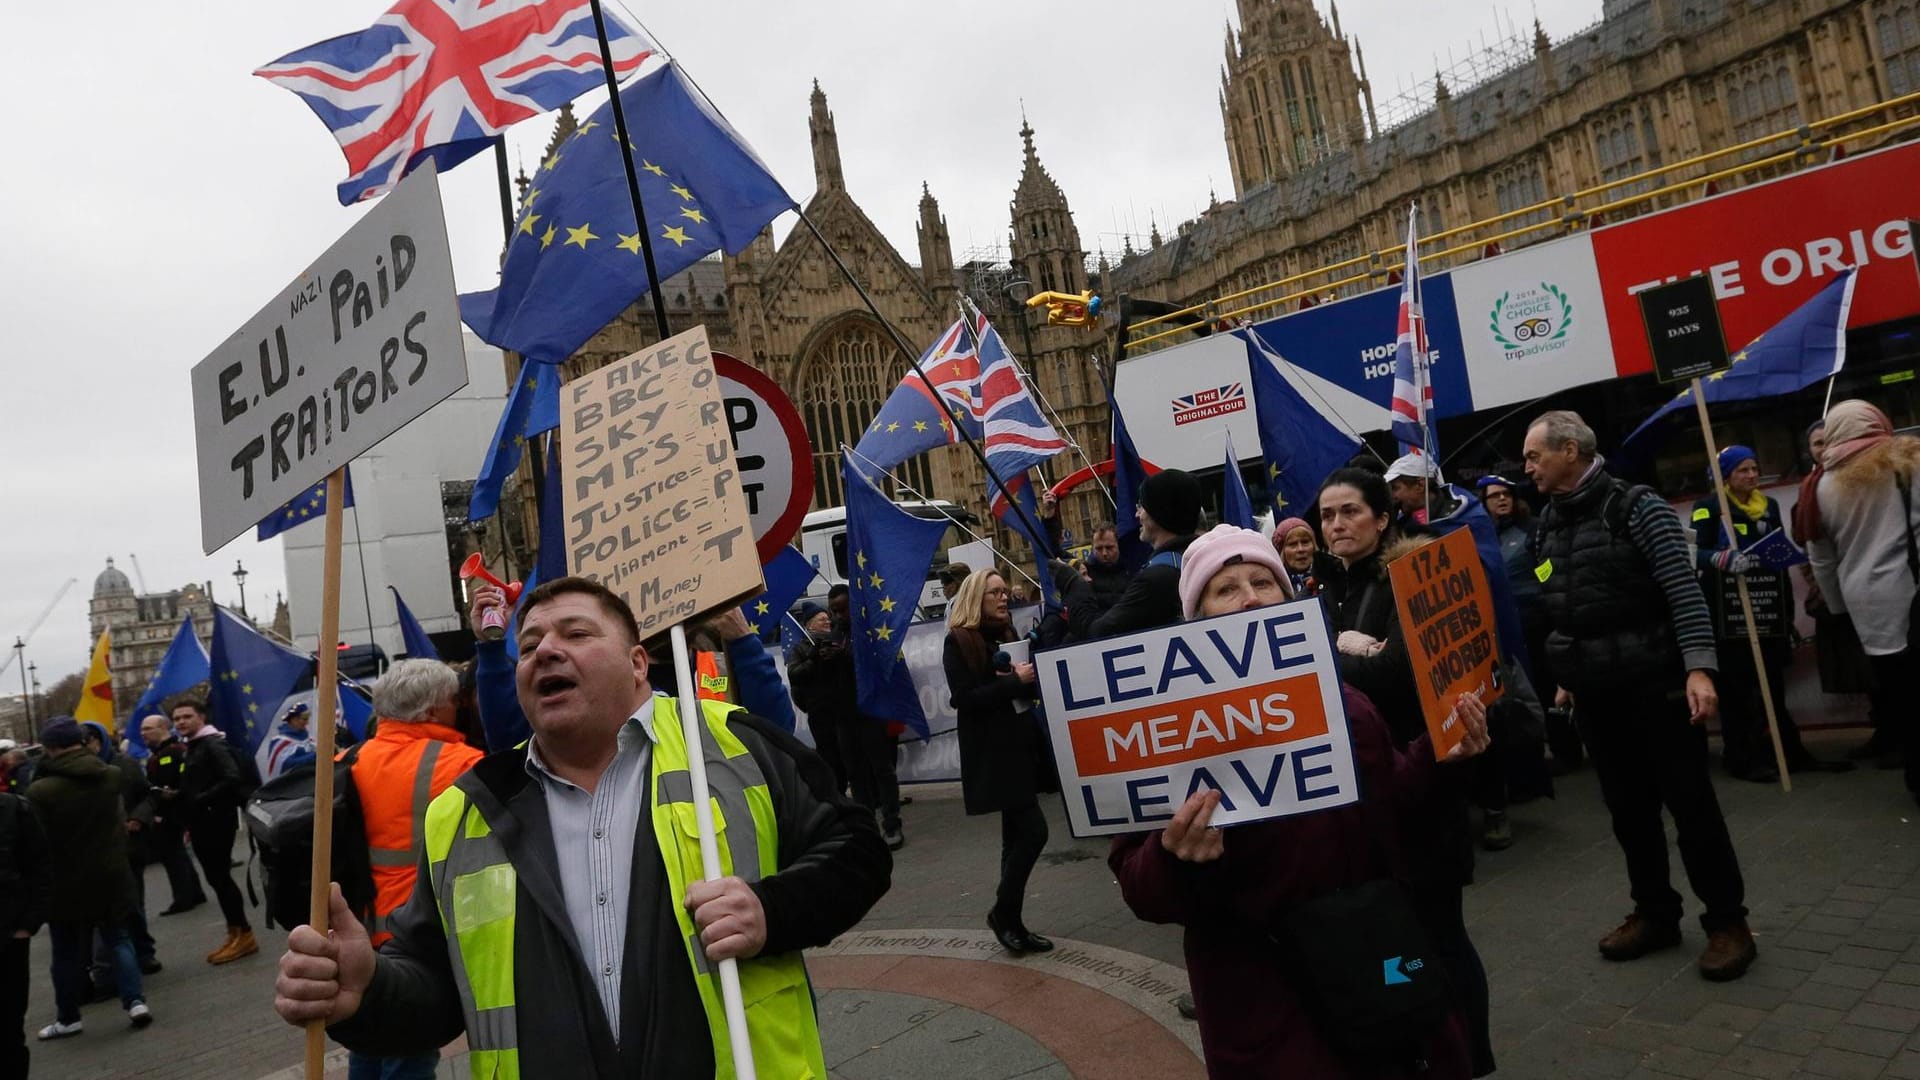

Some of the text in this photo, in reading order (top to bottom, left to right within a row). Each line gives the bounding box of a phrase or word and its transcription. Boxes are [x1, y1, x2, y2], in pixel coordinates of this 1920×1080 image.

[1506, 302, 1552, 320] CHOICE
[1516, 289, 1537, 300] 2018
[1668, 304, 1690, 318] 935
[218, 325, 305, 425] E.U.
[290, 275, 323, 320] NAZI
[1504, 339, 1569, 361] tripadvisor
[1667, 322, 1701, 338] DAYS
[573, 345, 679, 404] FAKE
[574, 373, 665, 434] BBC
[1197, 391, 1217, 404] THE
[575, 401, 669, 469] SKY
[1175, 399, 1244, 423] ORIGINAL TOUR
[1410, 542, 1451, 585] 17.4
[640, 574, 702, 613] Money
[1407, 566, 1475, 628] MILLION
[1418, 599, 1482, 661] VOTERS
[1055, 611, 1315, 712] LEAVE
[1428, 629, 1492, 701] IGNORED
[1102, 692, 1295, 763] MEANS
[1081, 743, 1341, 827] LEAVE
